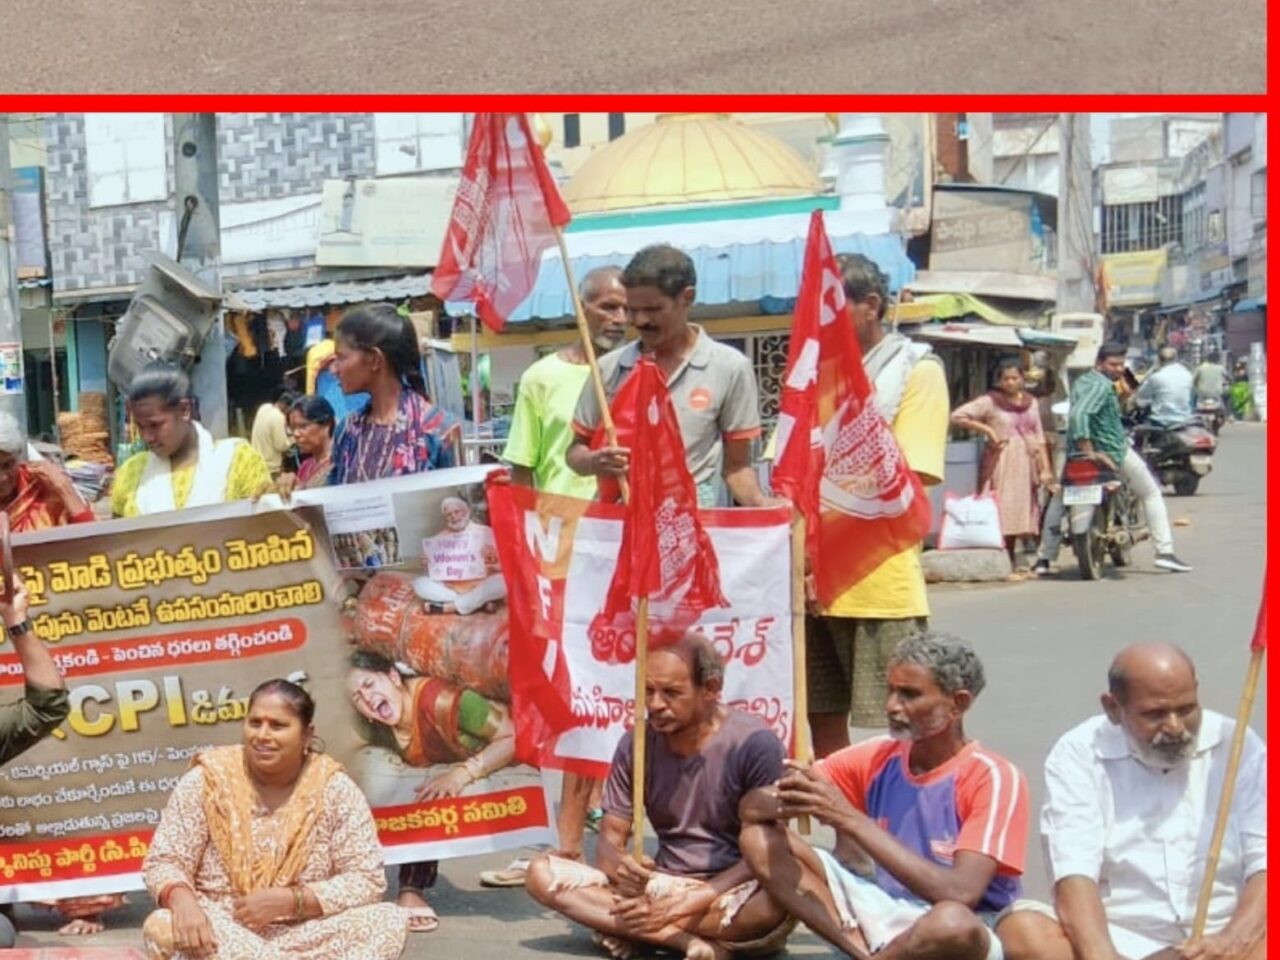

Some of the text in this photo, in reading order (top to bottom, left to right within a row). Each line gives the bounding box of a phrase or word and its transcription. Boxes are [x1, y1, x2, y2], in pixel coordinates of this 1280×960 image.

[49, 554, 112, 594] మోడి
[116, 543, 221, 589] ప్రభుత్వం
[225, 528, 314, 572] మోపిన
[86, 596, 151, 632] వెంటనే
[154, 579, 323, 622] ఉపసంహరించాలి
[68, 674, 188, 738] CPI
[131, 748, 164, 768] 115/-
[463, 795, 527, 825] సమితి
[56, 842, 96, 873] పార్టీ
